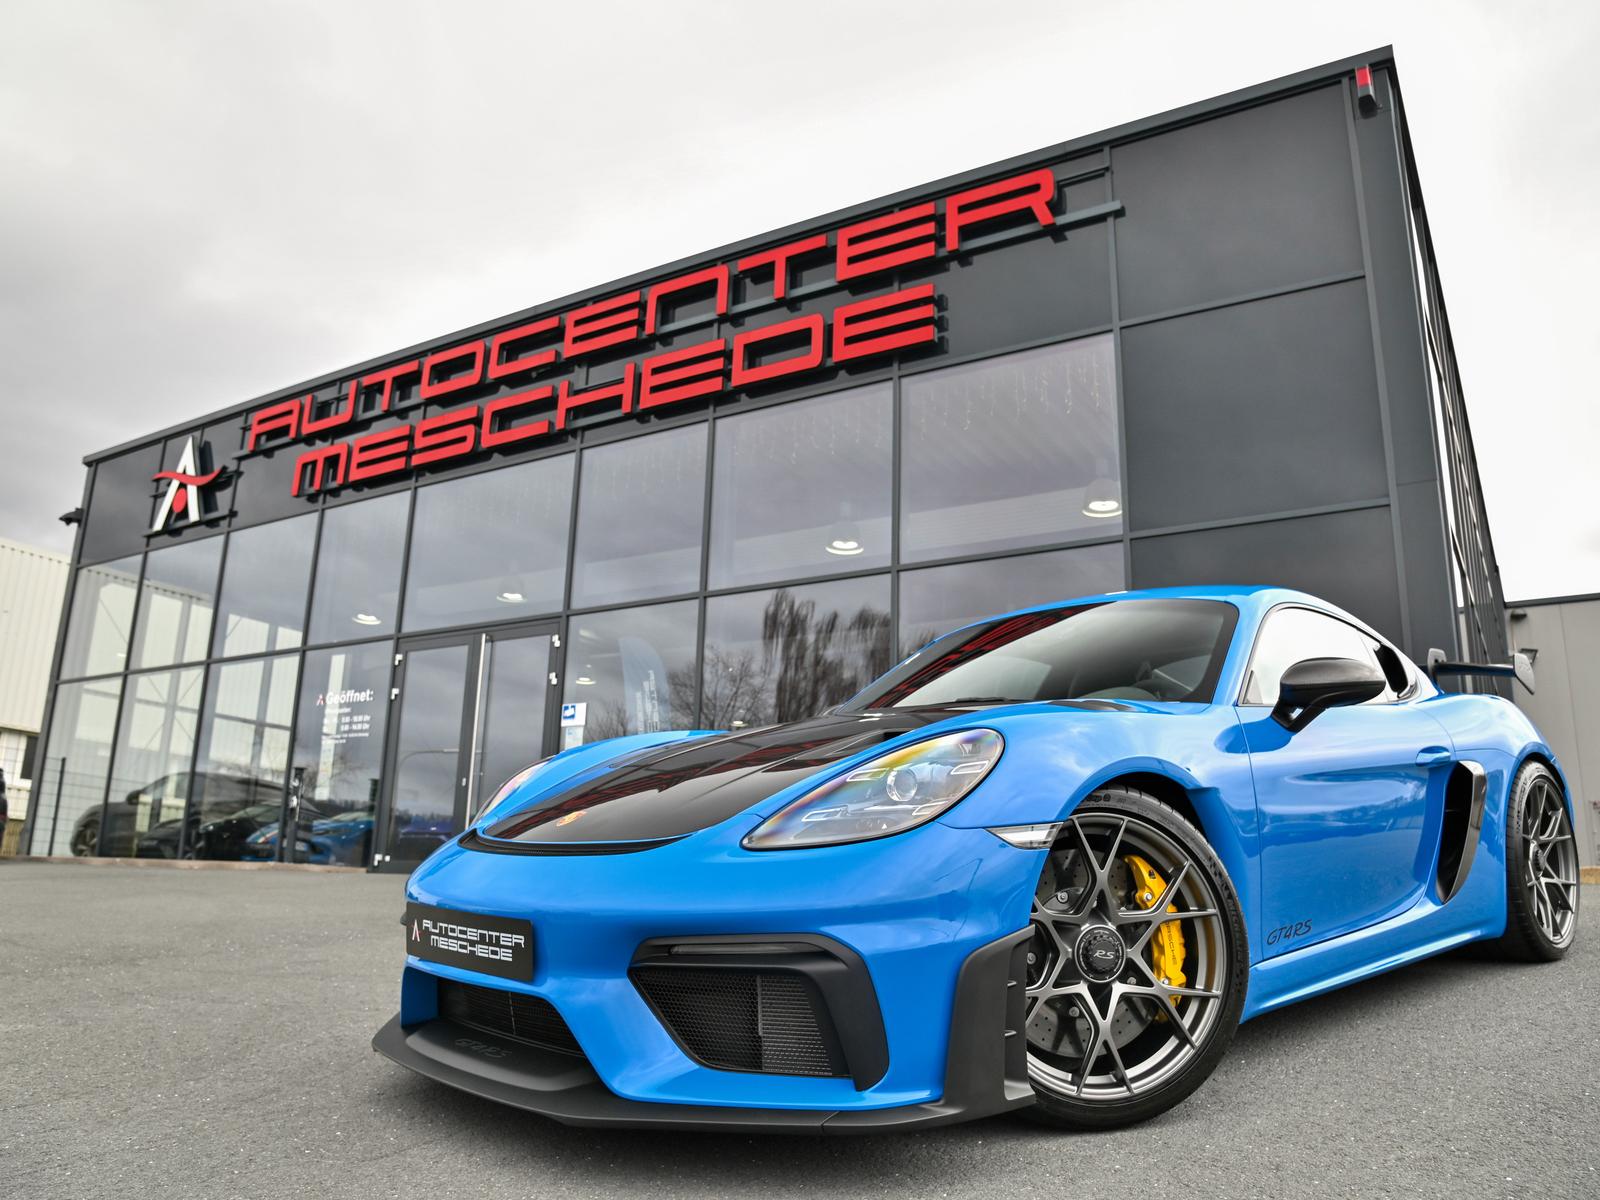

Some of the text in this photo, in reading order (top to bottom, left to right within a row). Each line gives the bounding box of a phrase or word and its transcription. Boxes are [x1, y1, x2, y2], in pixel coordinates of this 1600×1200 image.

[247, 168, 1056, 452] AUTOCENTER
[291, 283, 935, 497] MESCHEDE
[325, 689, 374, 705] Geöffnet:
[422, 919, 525, 948] AUTOCENTER
[1165, 921, 1178, 965] ORSCHE
[1266, 918, 1313, 945] GT4RS
[431, 934, 513, 962] MESCHEDE
